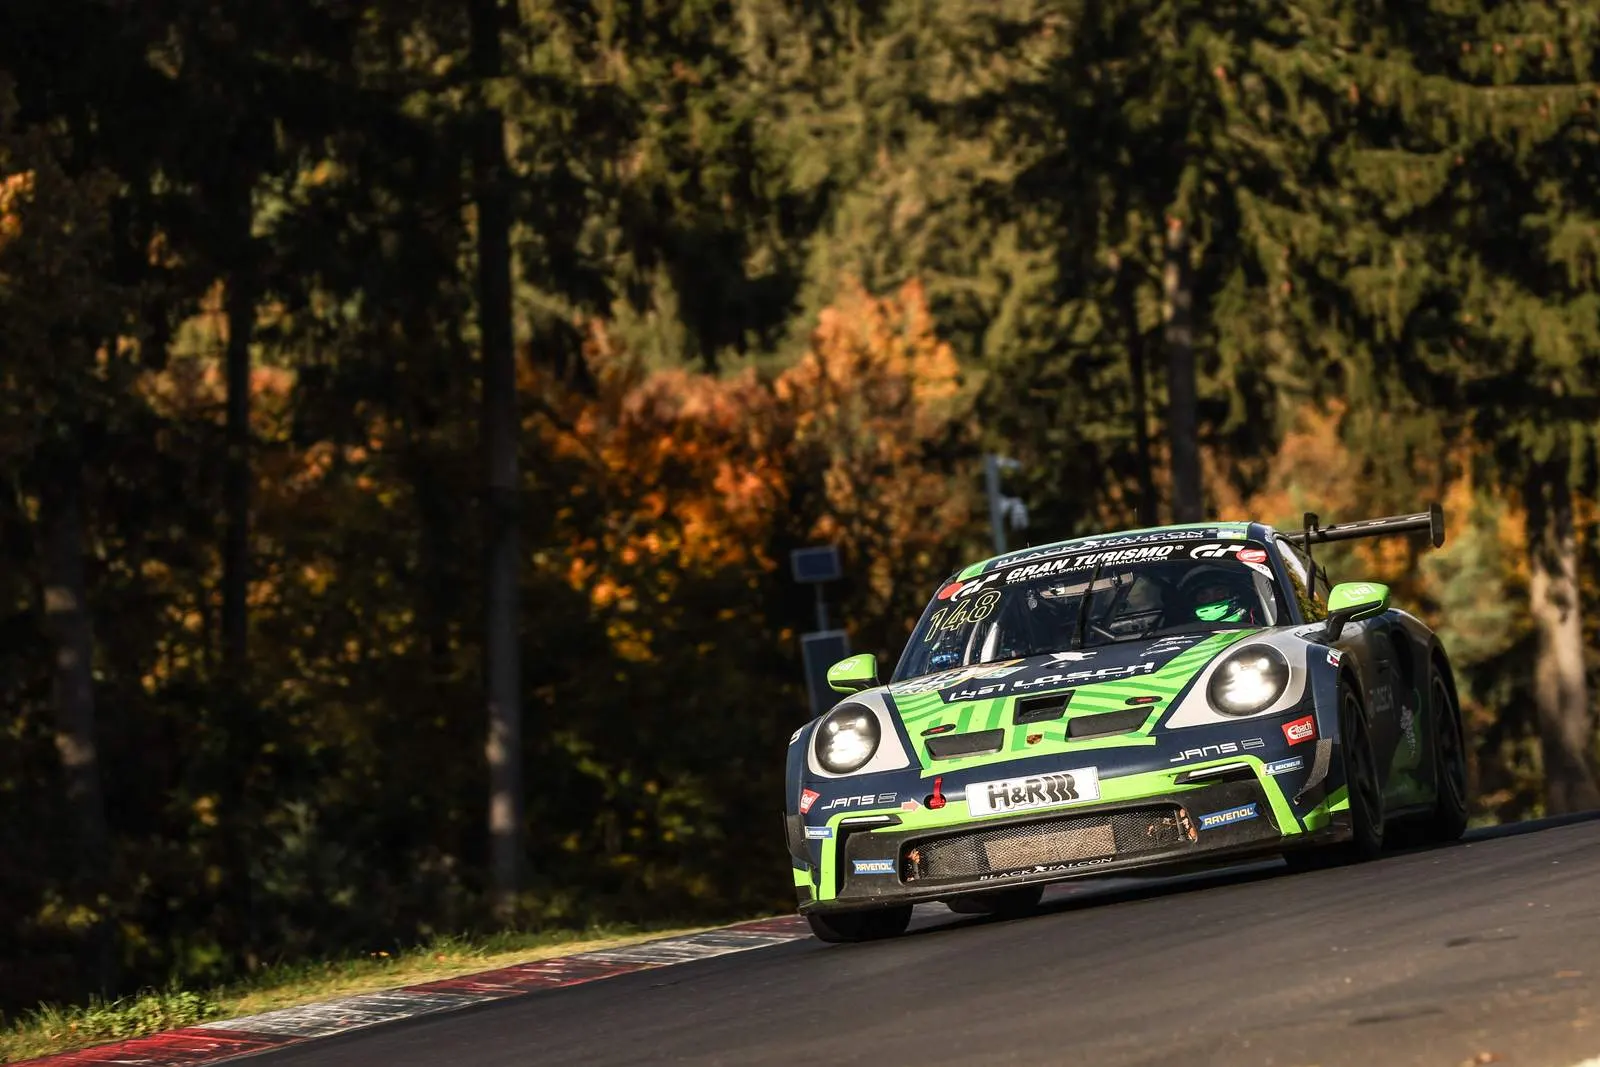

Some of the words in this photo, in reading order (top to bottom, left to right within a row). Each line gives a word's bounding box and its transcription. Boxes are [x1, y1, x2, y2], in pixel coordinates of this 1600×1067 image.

[1006, 558, 1071, 581] GRAN
[1006, 576, 1027, 584] THE
[1028, 571, 1056, 580] REAL
[1104, 556, 1168, 567] SIMULATOR
[924, 589, 1002, 642] 148
[1013, 662, 1155, 688] LOSCH
[987, 777, 1047, 809] H&R
[1203, 807, 1255, 826] RAVENOL
[855, 862, 893, 872] RAVENOL
[980, 869, 1031, 881] BLACK
[1048, 857, 1113, 871] FALCON
